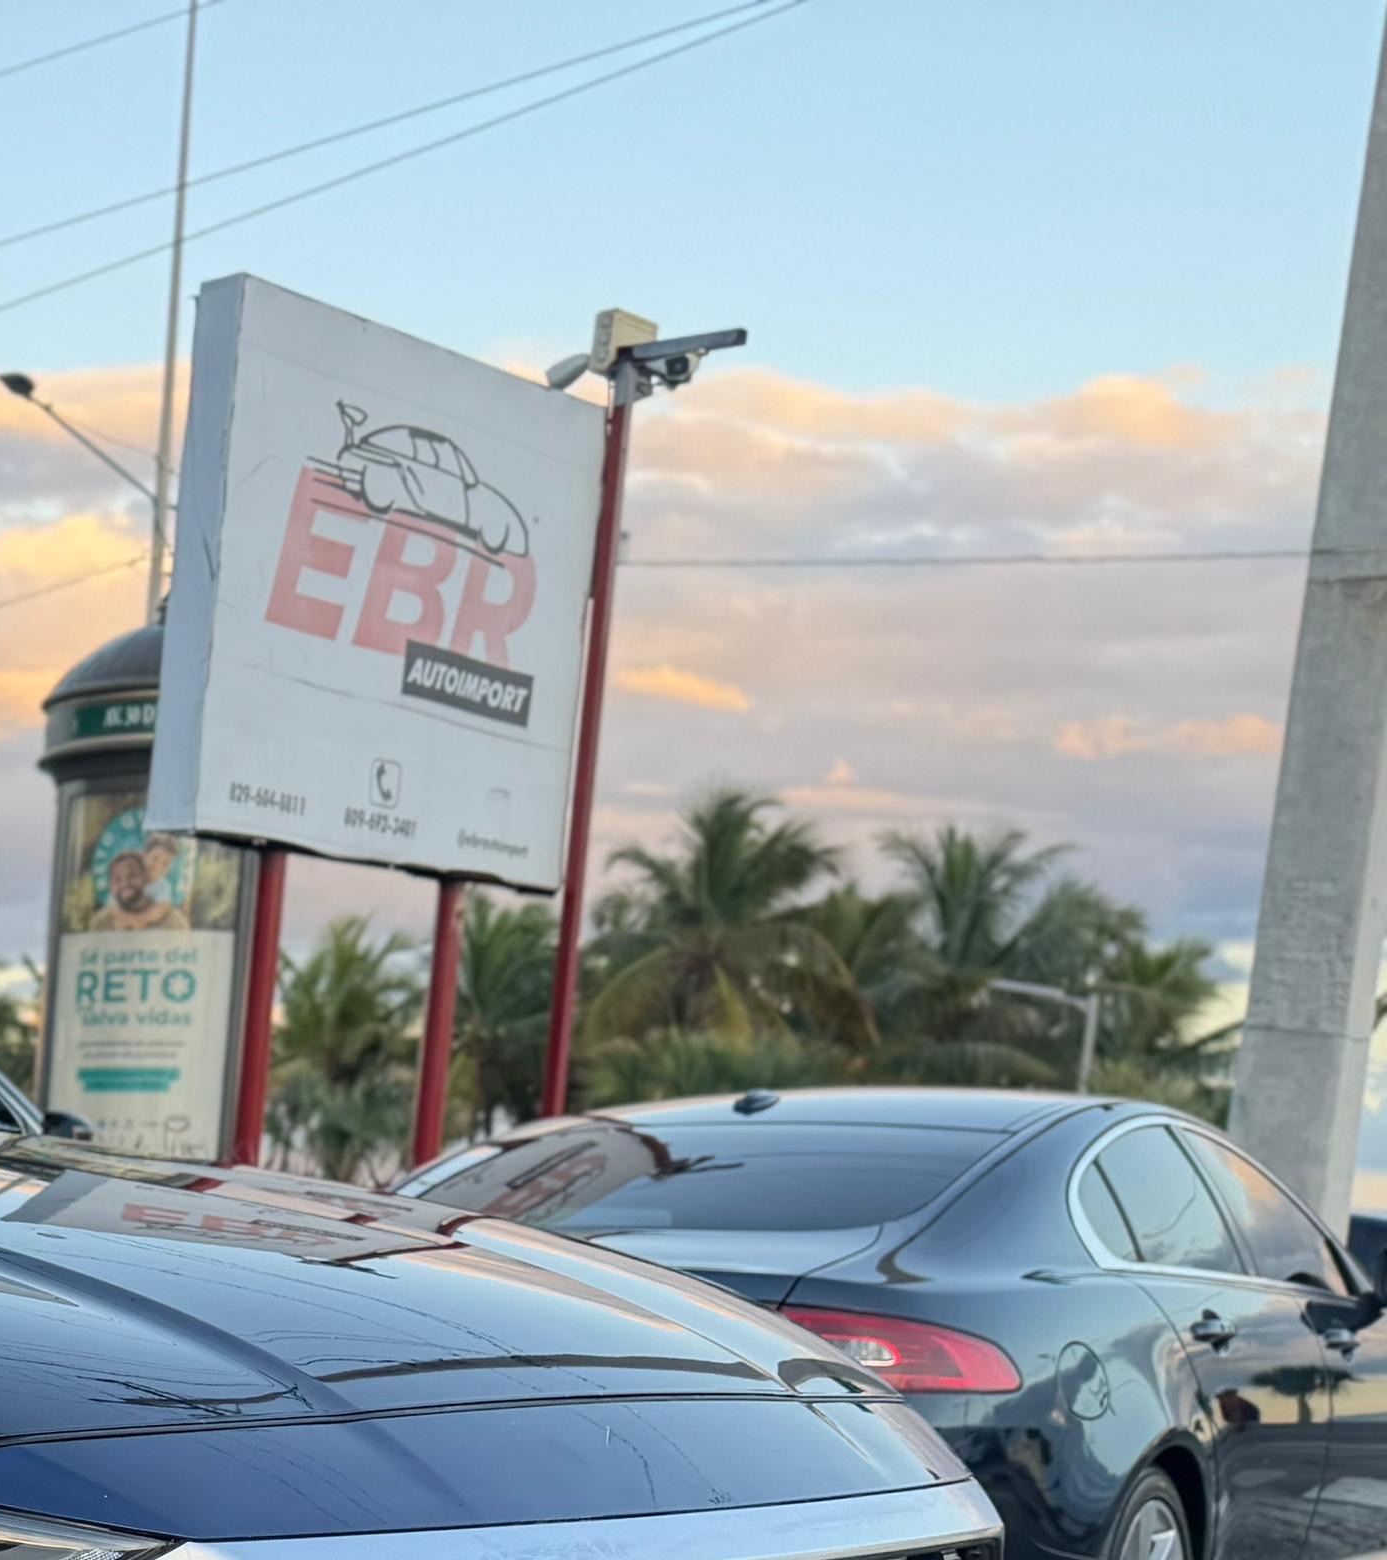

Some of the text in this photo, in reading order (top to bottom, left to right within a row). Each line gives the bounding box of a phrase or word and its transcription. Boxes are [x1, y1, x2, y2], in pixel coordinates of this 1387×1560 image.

[264, 465, 537, 670] EBR
[406, 657, 528, 714] AUTOIMPORT
[76, 968, 197, 1004] RETO
